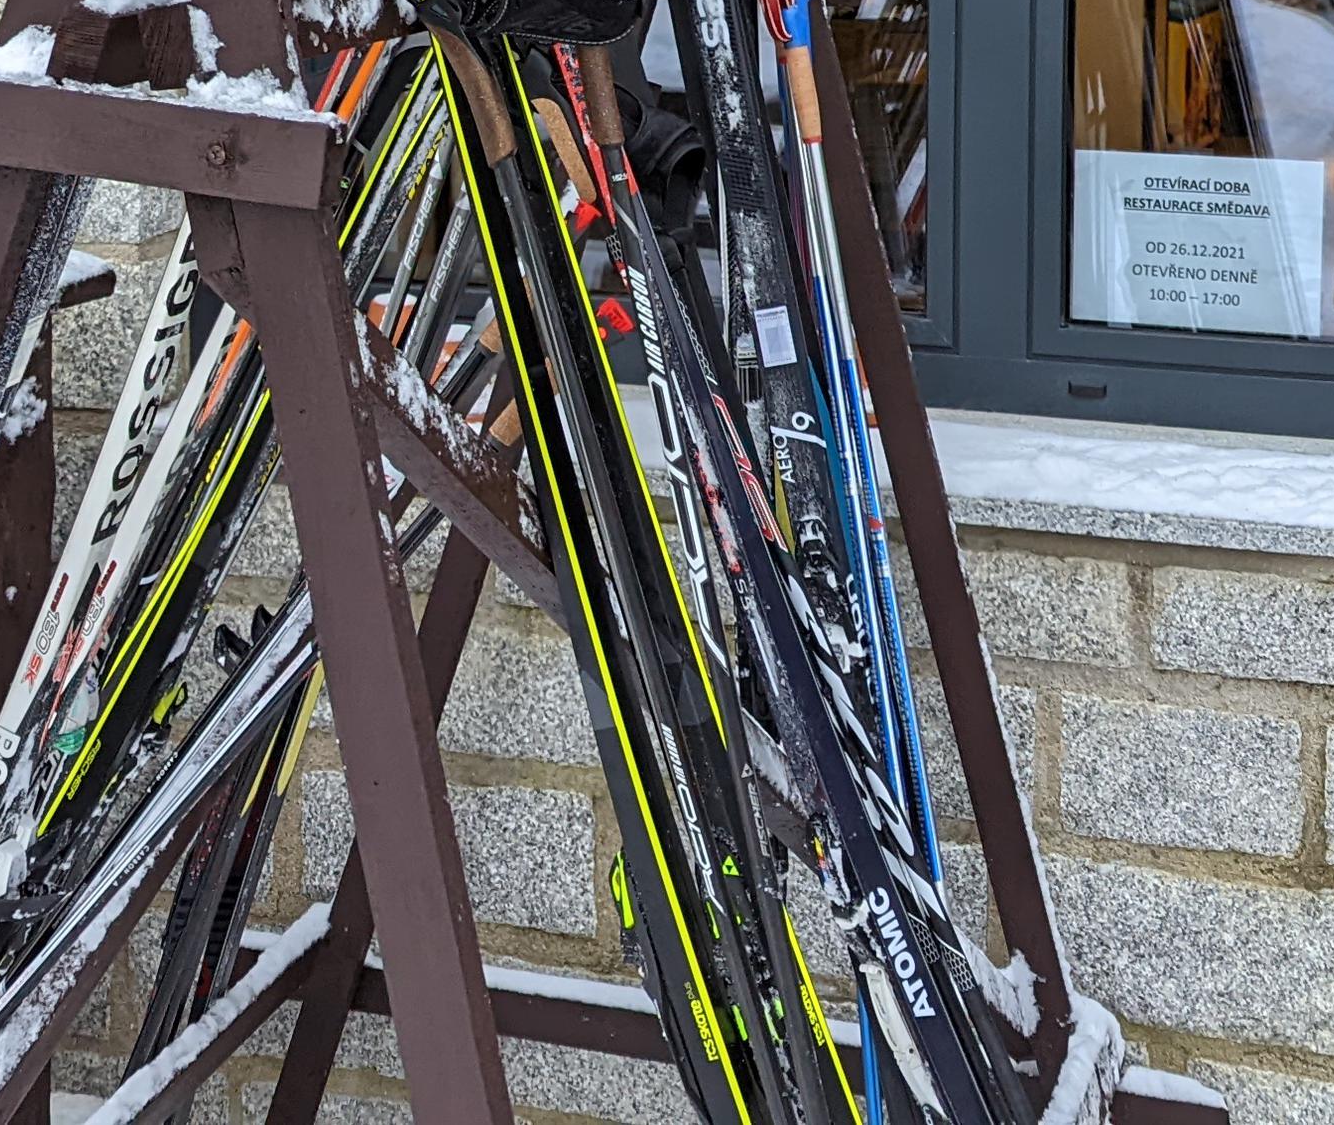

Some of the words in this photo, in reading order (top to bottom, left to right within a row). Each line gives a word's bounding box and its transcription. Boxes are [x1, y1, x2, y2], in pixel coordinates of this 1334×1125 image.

[1144, 176, 1211, 192] OTEVÍRACÍ
[1214, 181, 1250, 194] DOBA
[402, 184, 437, 270] FISCHER
[1124, 197, 1203, 213] RESTAURACE
[1207, 199, 1271, 216] SMĚDAVA
[430, 216, 465, 302] FISCHER
[1145, 241, 1166, 254] OD
[1170, 243, 1245, 259] 26.12.2021
[1132, 262, 1207, 280] OTEVŘENO
[1210, 266, 1258, 284] DENNĚ
[628, 265, 660, 340] CARBON
[1150, 288, 1187, 302] 10:00
[1203, 292, 1241, 306] 17:00
[643, 339, 666, 375] AIR
[91, 233, 199, 546] ROSSIG
[36, 611, 60, 655] 180
[67, 738, 101, 800] FISCHER
[747, 782, 771, 857] FISCHER
[123, 845, 150, 875] CARBON
[869, 887, 936, 1018] ATOMIC
[683, 980, 697, 1001] plus
[690, 999, 714, 1041] skate
